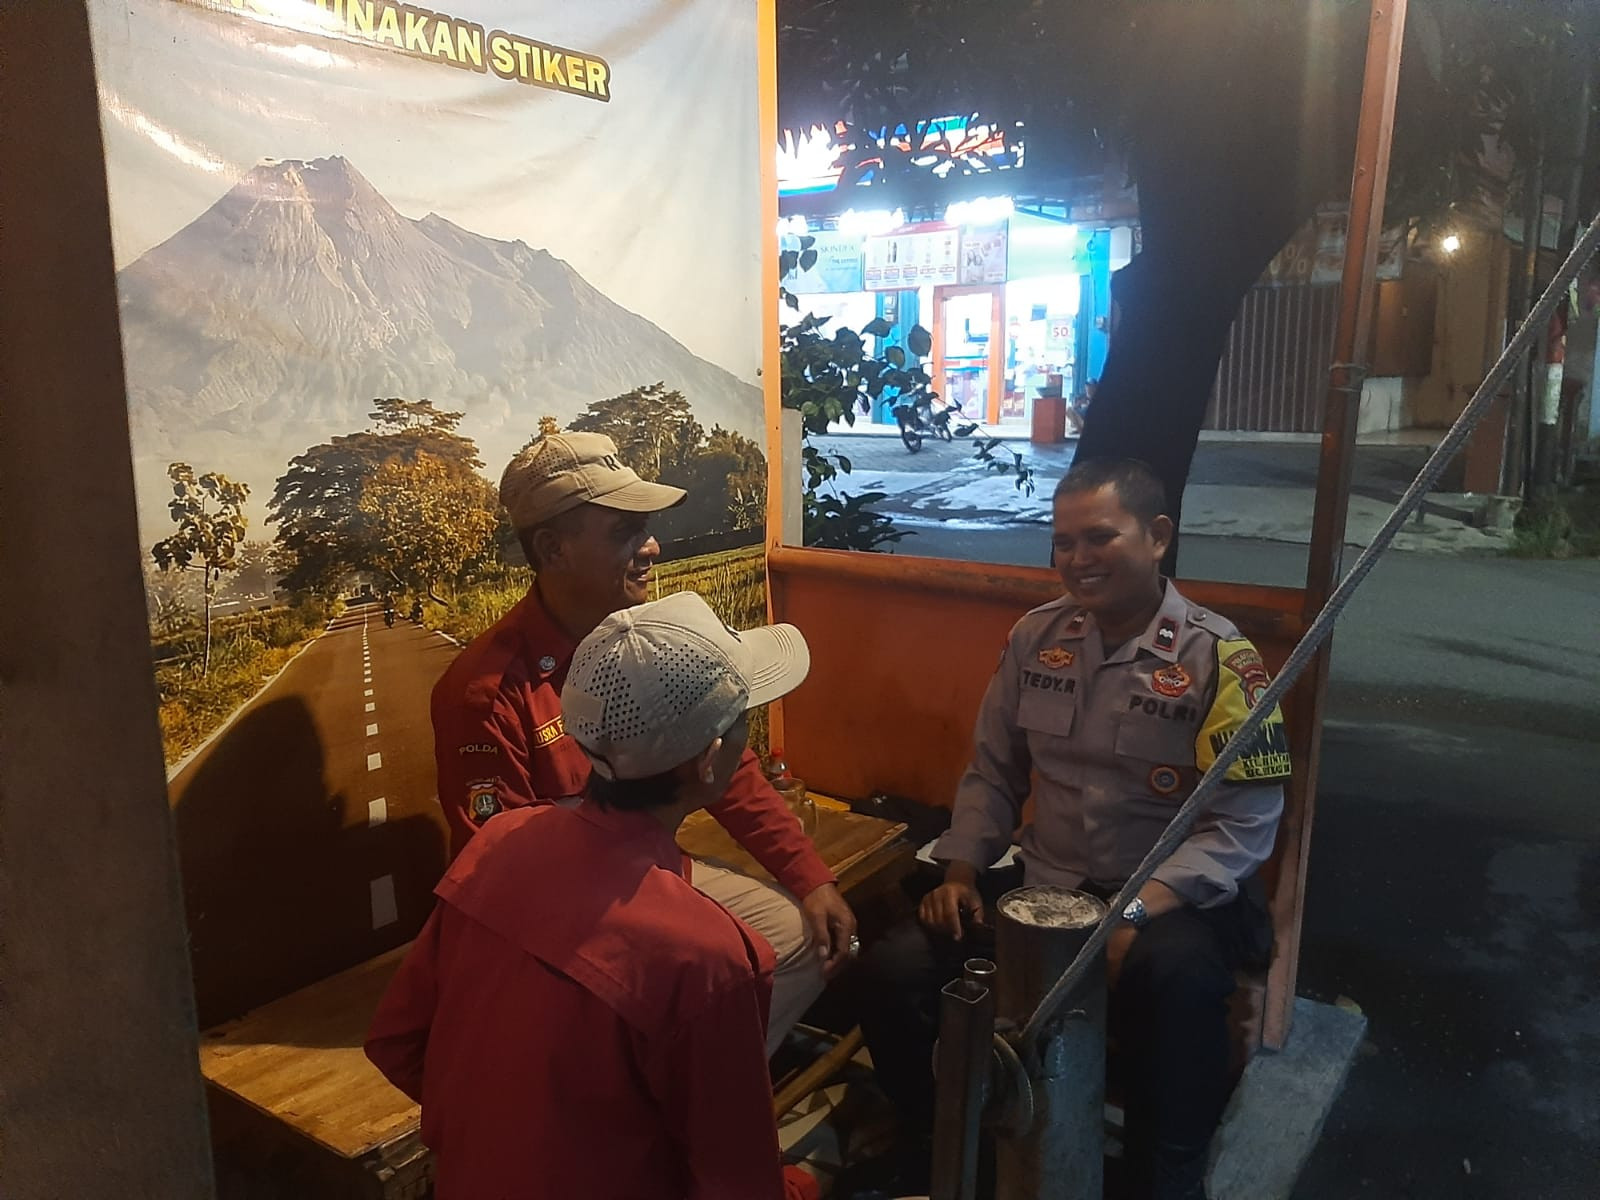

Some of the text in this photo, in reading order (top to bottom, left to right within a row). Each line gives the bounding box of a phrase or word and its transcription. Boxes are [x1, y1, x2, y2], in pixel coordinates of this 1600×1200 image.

[491, 36, 607, 97] STIKER
[601, 453, 621, 472] R
[1128, 694, 1198, 722] POLRI
[458, 744, 499, 757] POLDA
